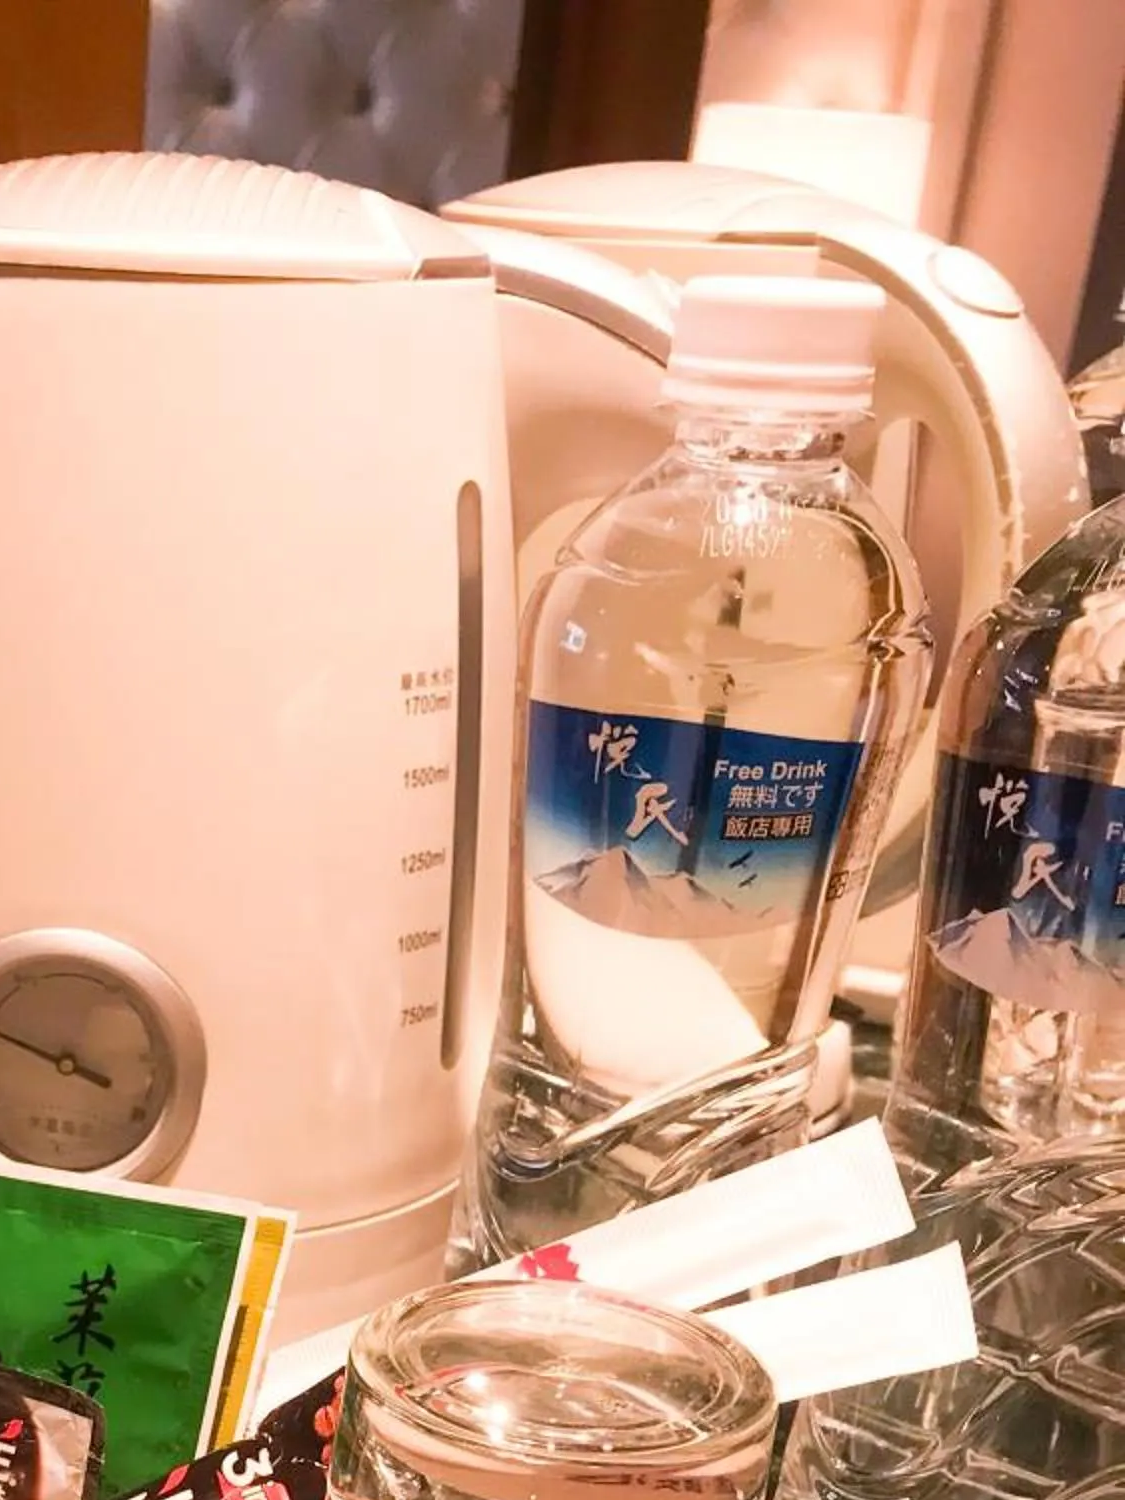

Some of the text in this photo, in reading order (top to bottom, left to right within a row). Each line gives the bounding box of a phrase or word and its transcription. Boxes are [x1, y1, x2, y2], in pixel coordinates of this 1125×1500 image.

[405, 690, 452, 716] 1700ml
[404, 764, 450, 789] 1500ml
[715, 760, 828, 780] Free Drink
[727, 782, 824, 808] 無料です
[401, 847, 446, 875] 1250ml
[398, 927, 442, 954] 1000ml
[400, 1001, 438, 1028] 750ml
